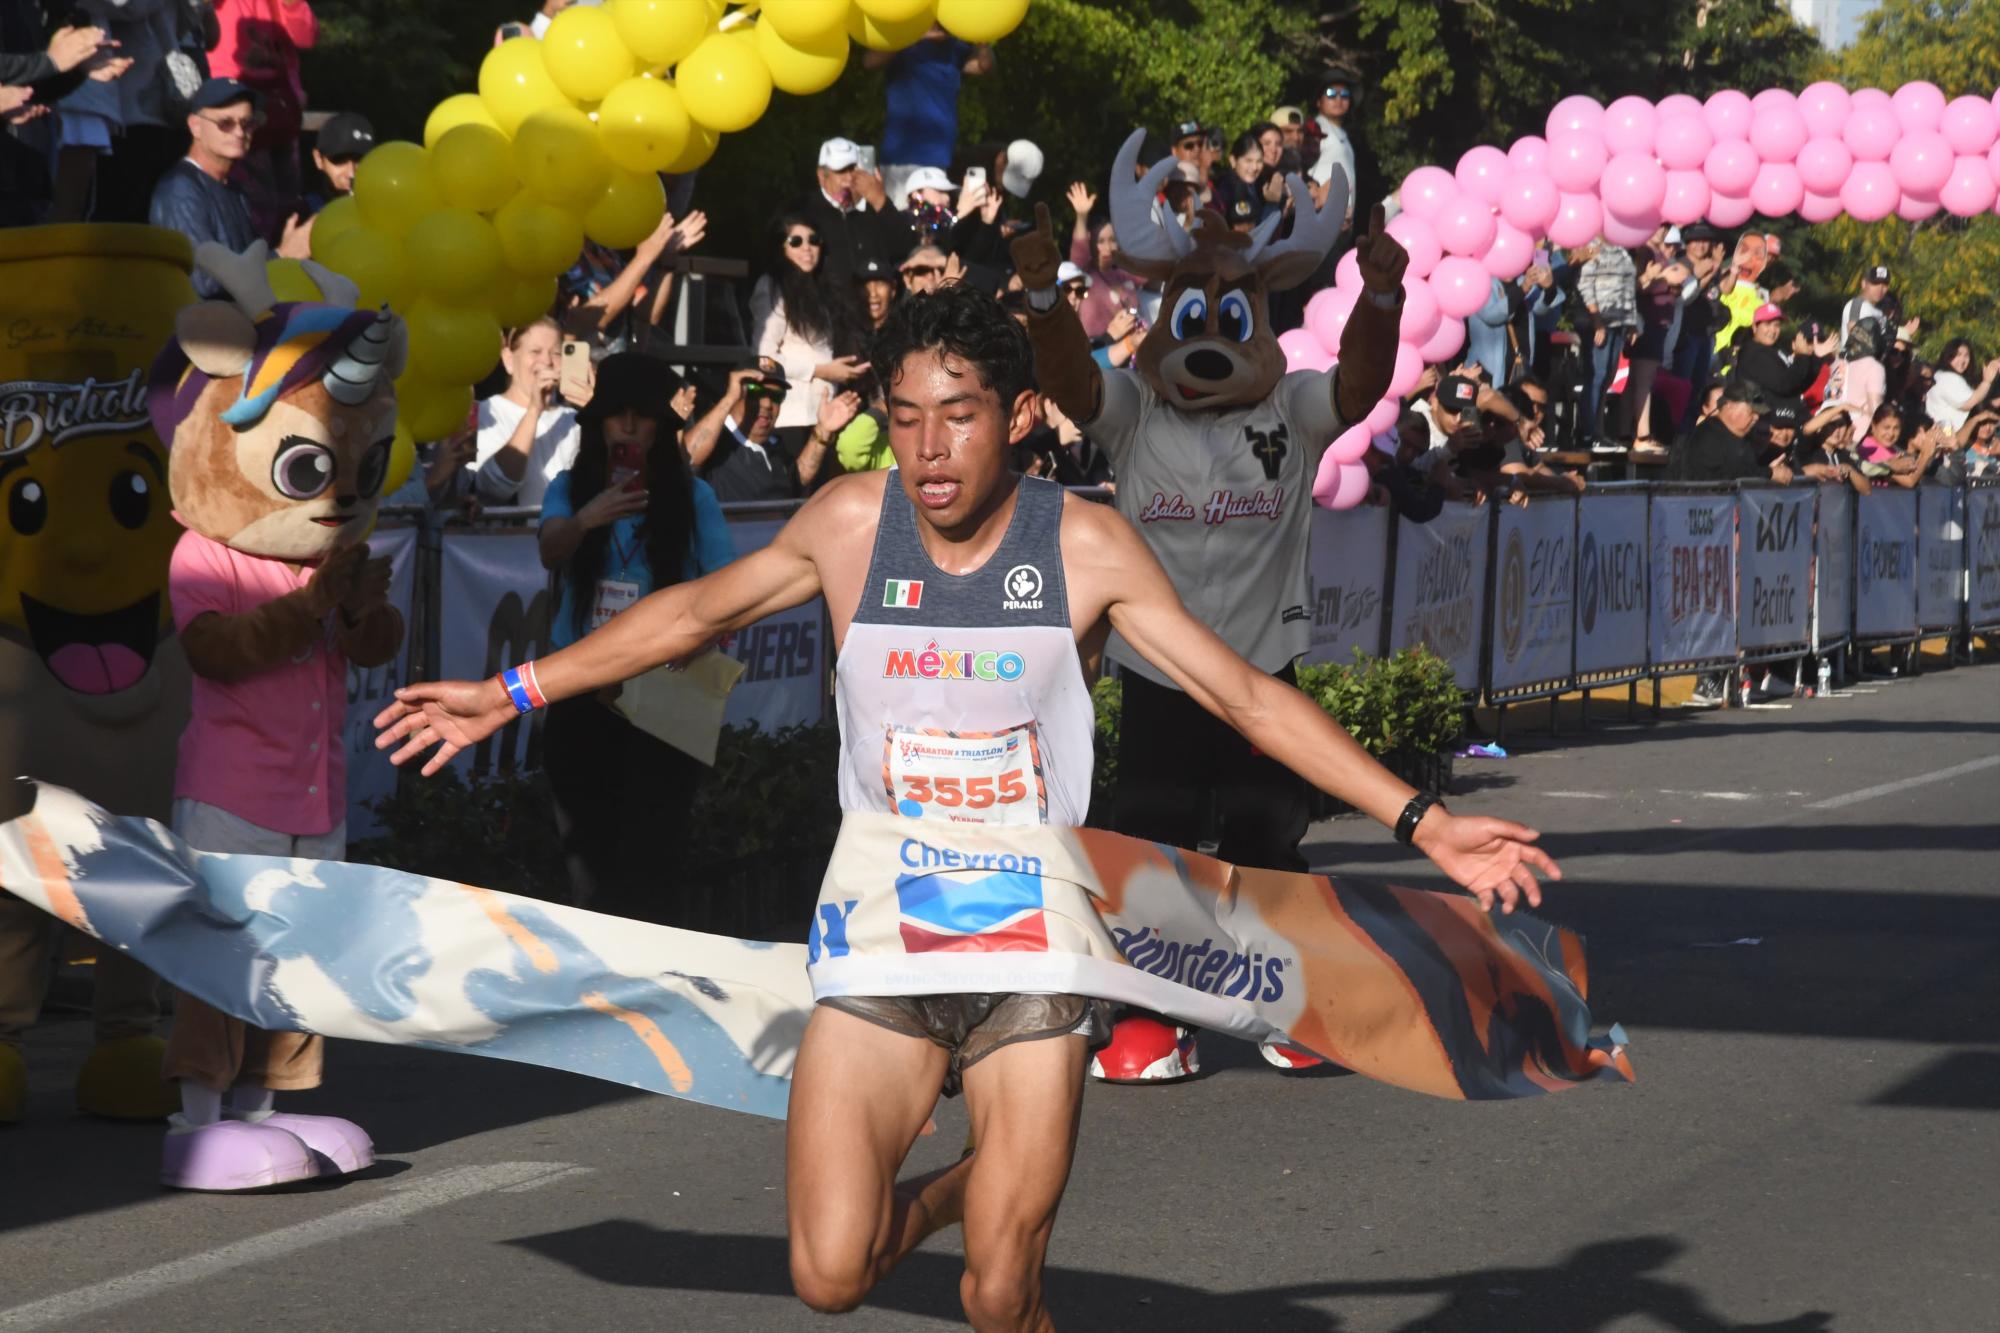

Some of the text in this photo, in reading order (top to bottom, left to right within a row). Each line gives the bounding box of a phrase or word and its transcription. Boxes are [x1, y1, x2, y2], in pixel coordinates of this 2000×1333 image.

[1141, 487, 1285, 525] Salsa Huichol
[1689, 508, 1713, 536] TACOS
[1756, 502, 1800, 552] KIA
[1600, 543, 1644, 613] MEGA
[1003, 600, 1043, 610] PERALES
[1752, 573, 1794, 628] Pacific
[902, 768, 1027, 809] 3555
[900, 838, 1042, 875] Chevron
